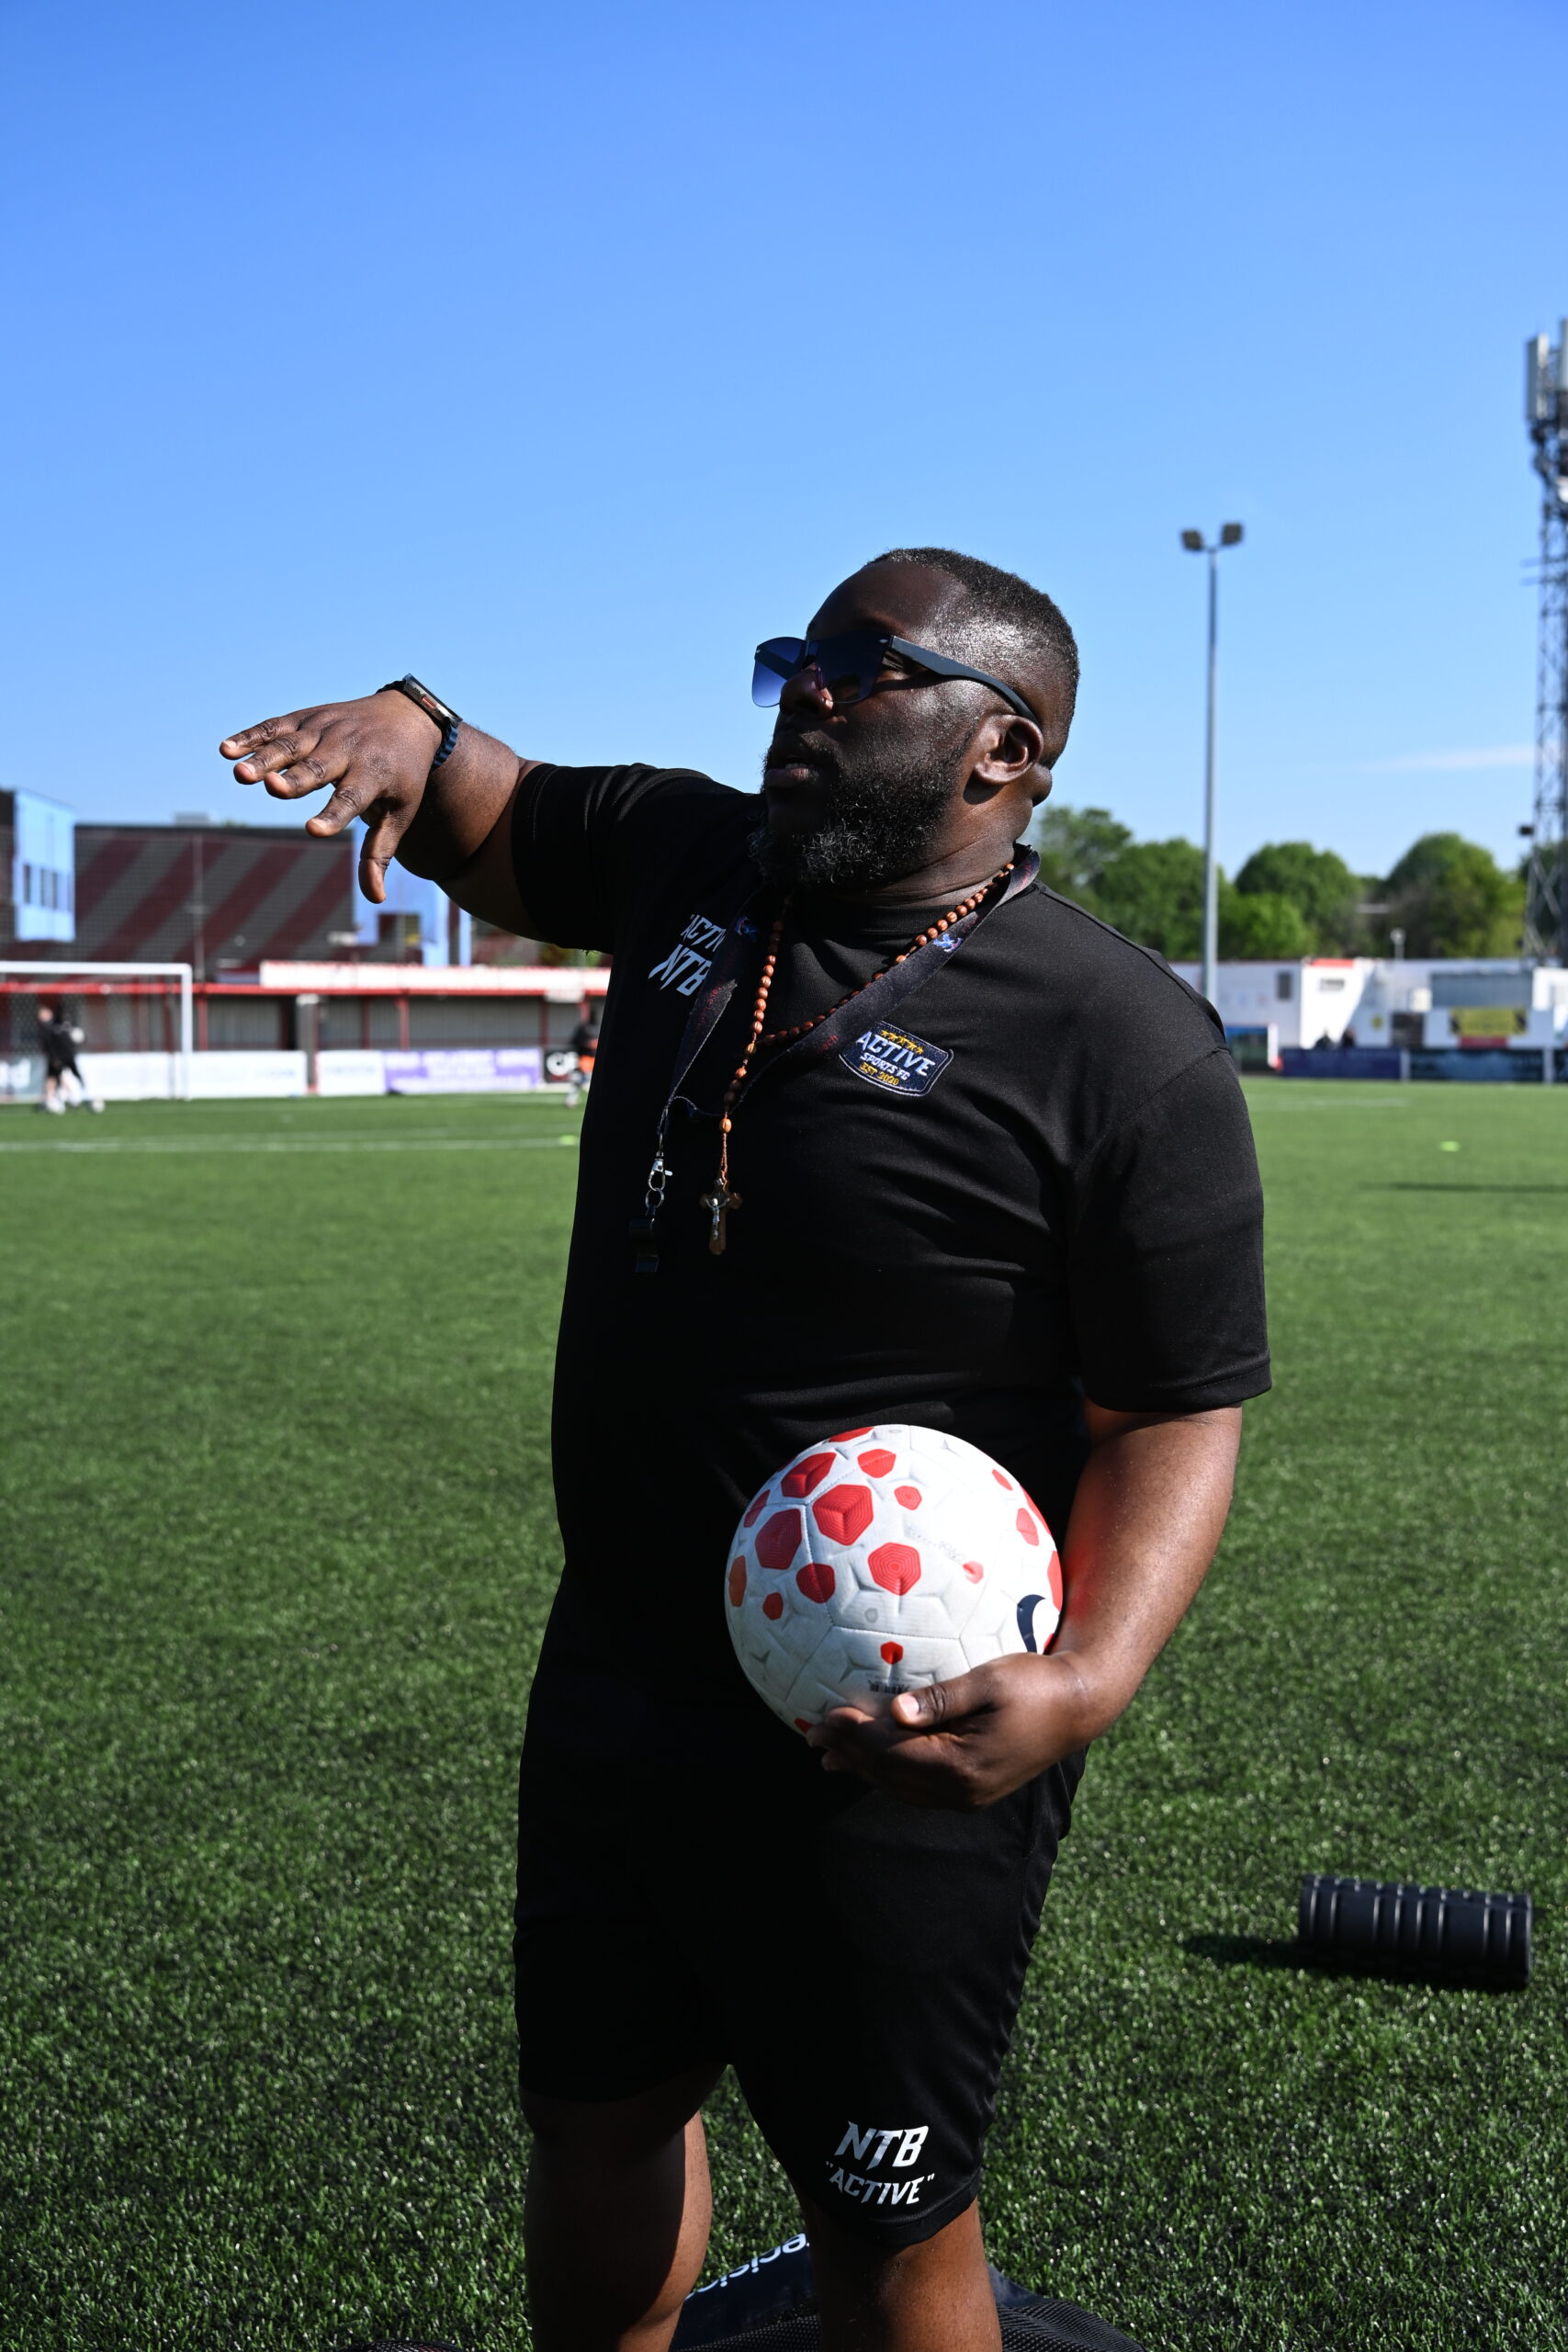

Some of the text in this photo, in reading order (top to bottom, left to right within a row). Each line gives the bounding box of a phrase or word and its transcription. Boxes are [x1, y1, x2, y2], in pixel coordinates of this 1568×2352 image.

[648, 944, 713, 996] NTB
[855, 1031, 936, 1076] ACTIVE
[859, 1061, 900, 1085] EST 2020
[860, 1052, 897, 1074] SPORTS
[834, 2120, 929, 2170] NTB
